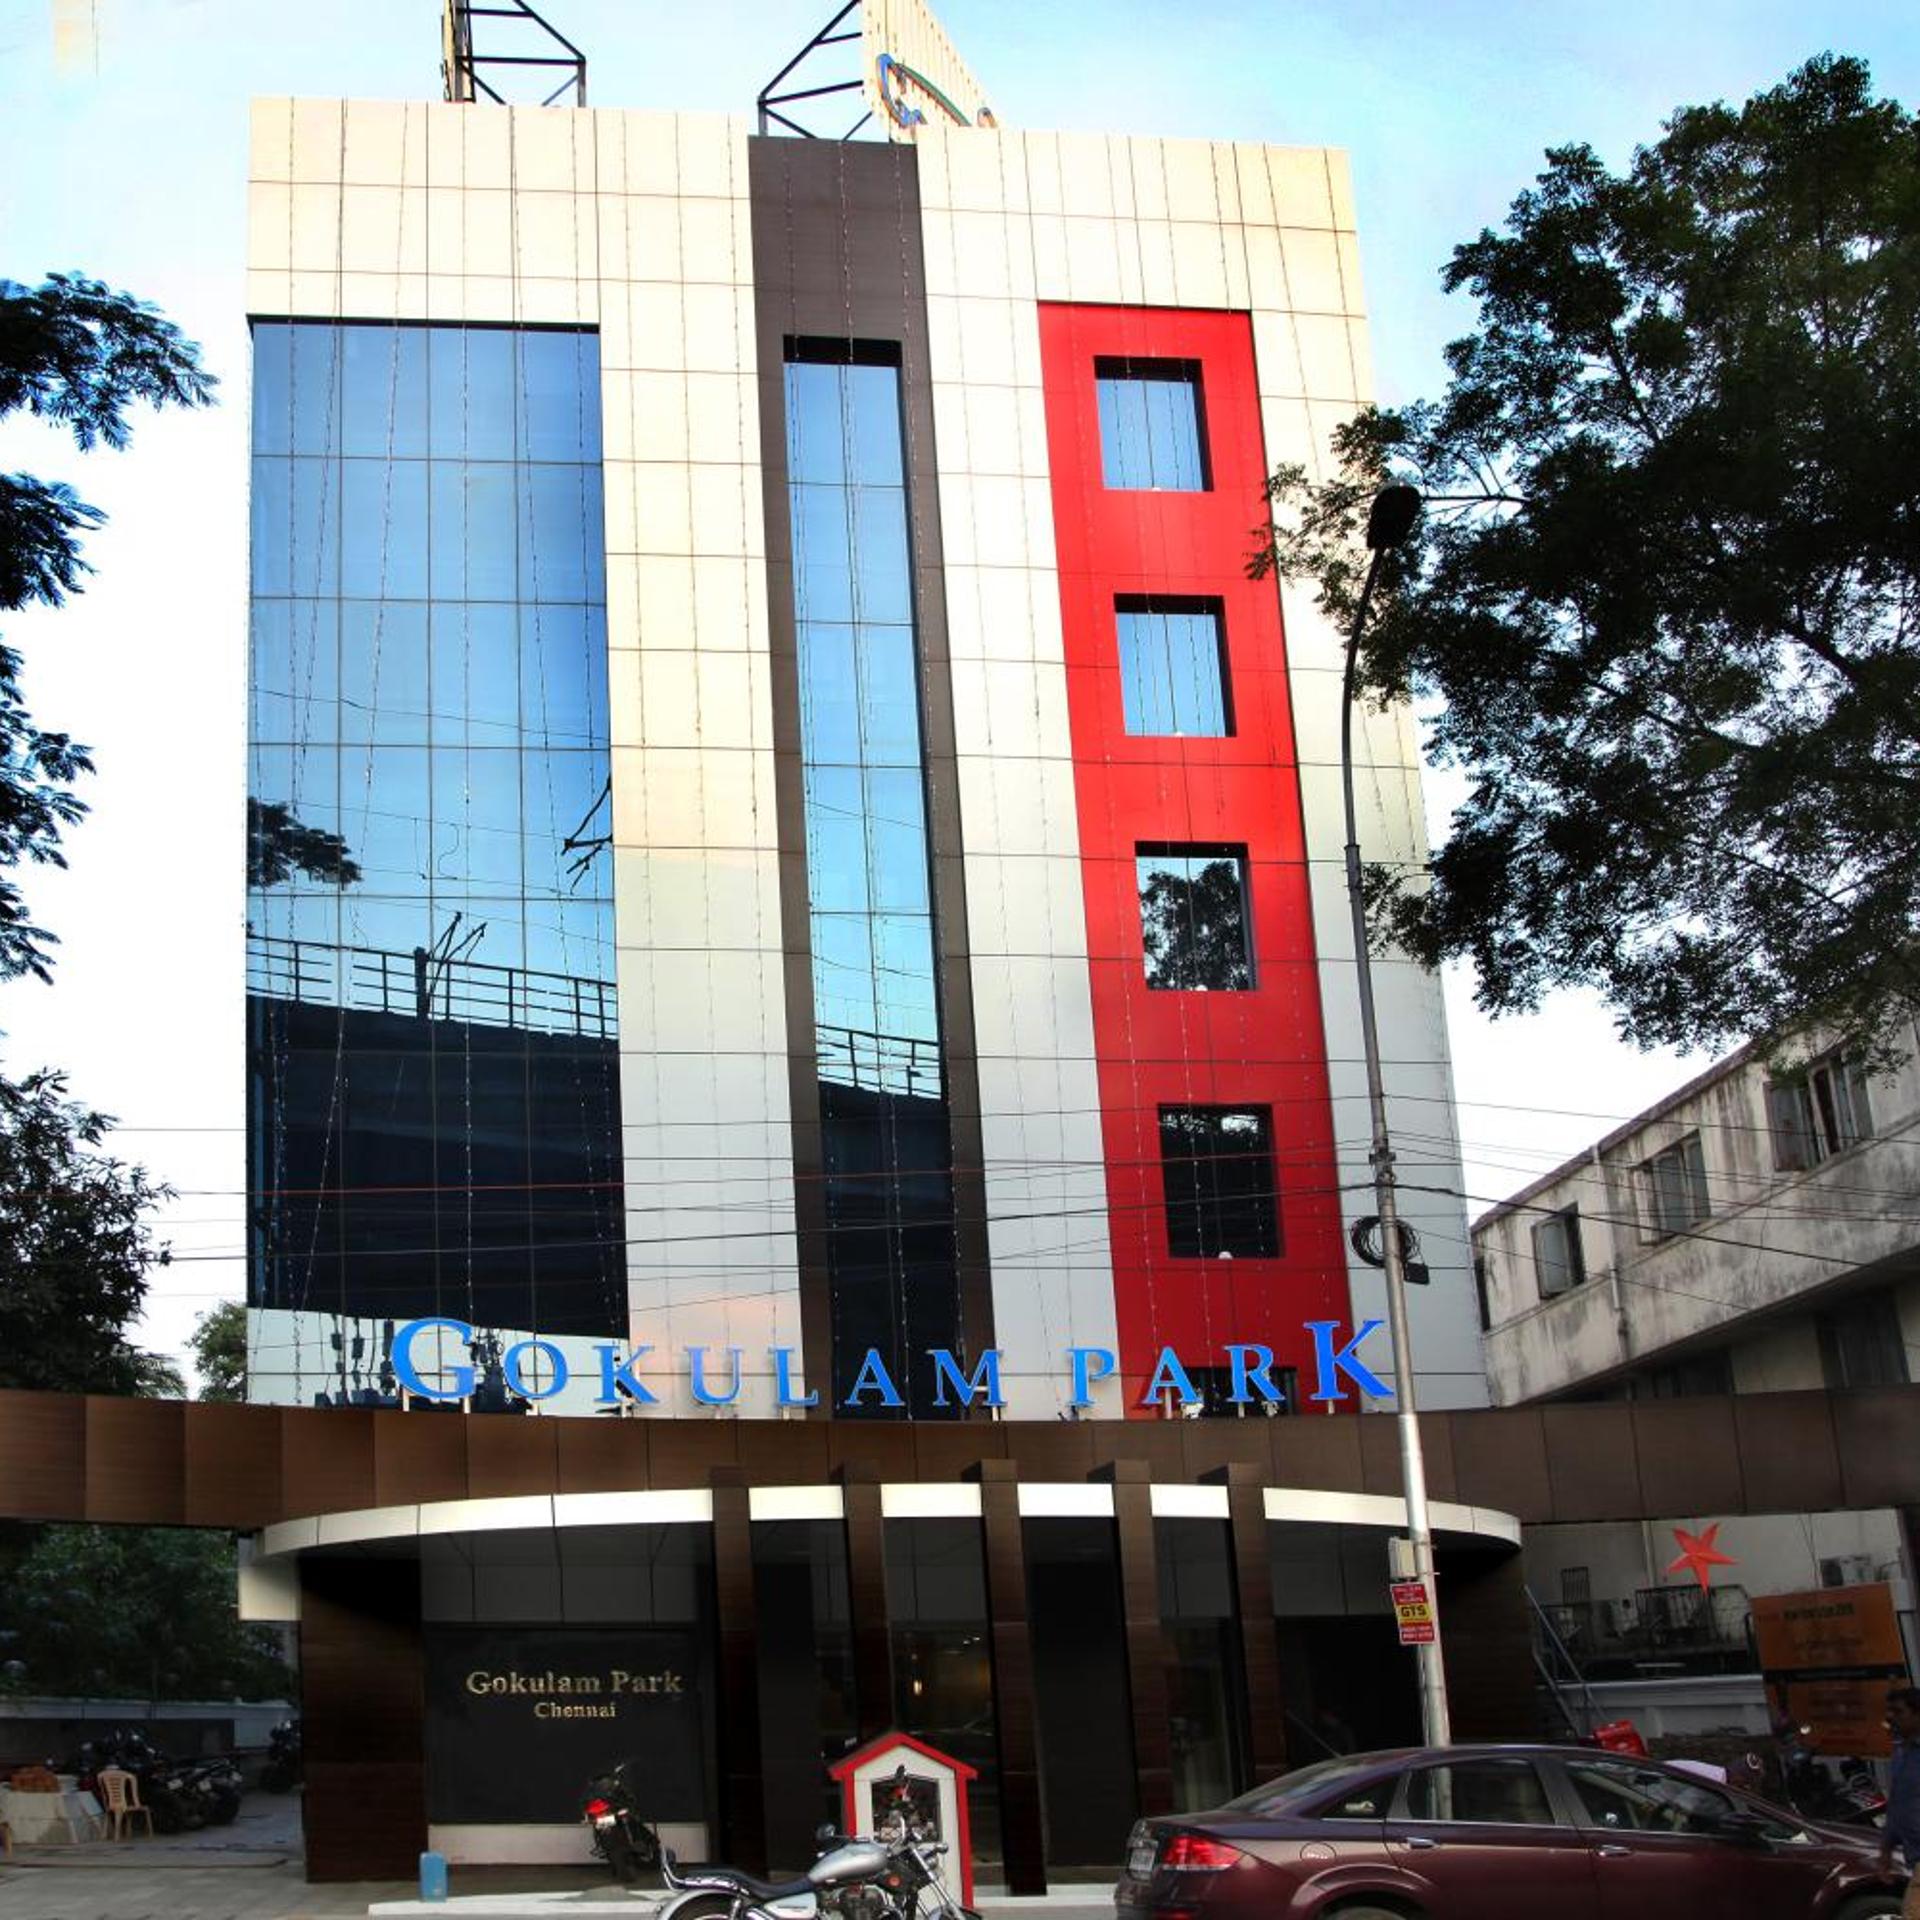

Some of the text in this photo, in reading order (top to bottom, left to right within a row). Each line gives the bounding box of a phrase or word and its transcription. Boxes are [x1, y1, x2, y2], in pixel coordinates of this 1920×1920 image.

[391, 1316, 1396, 1406] GOKULAM PARK
[465, 1669, 683, 1695] Gokulam Park
[533, 1701, 616, 1719] Chennai
